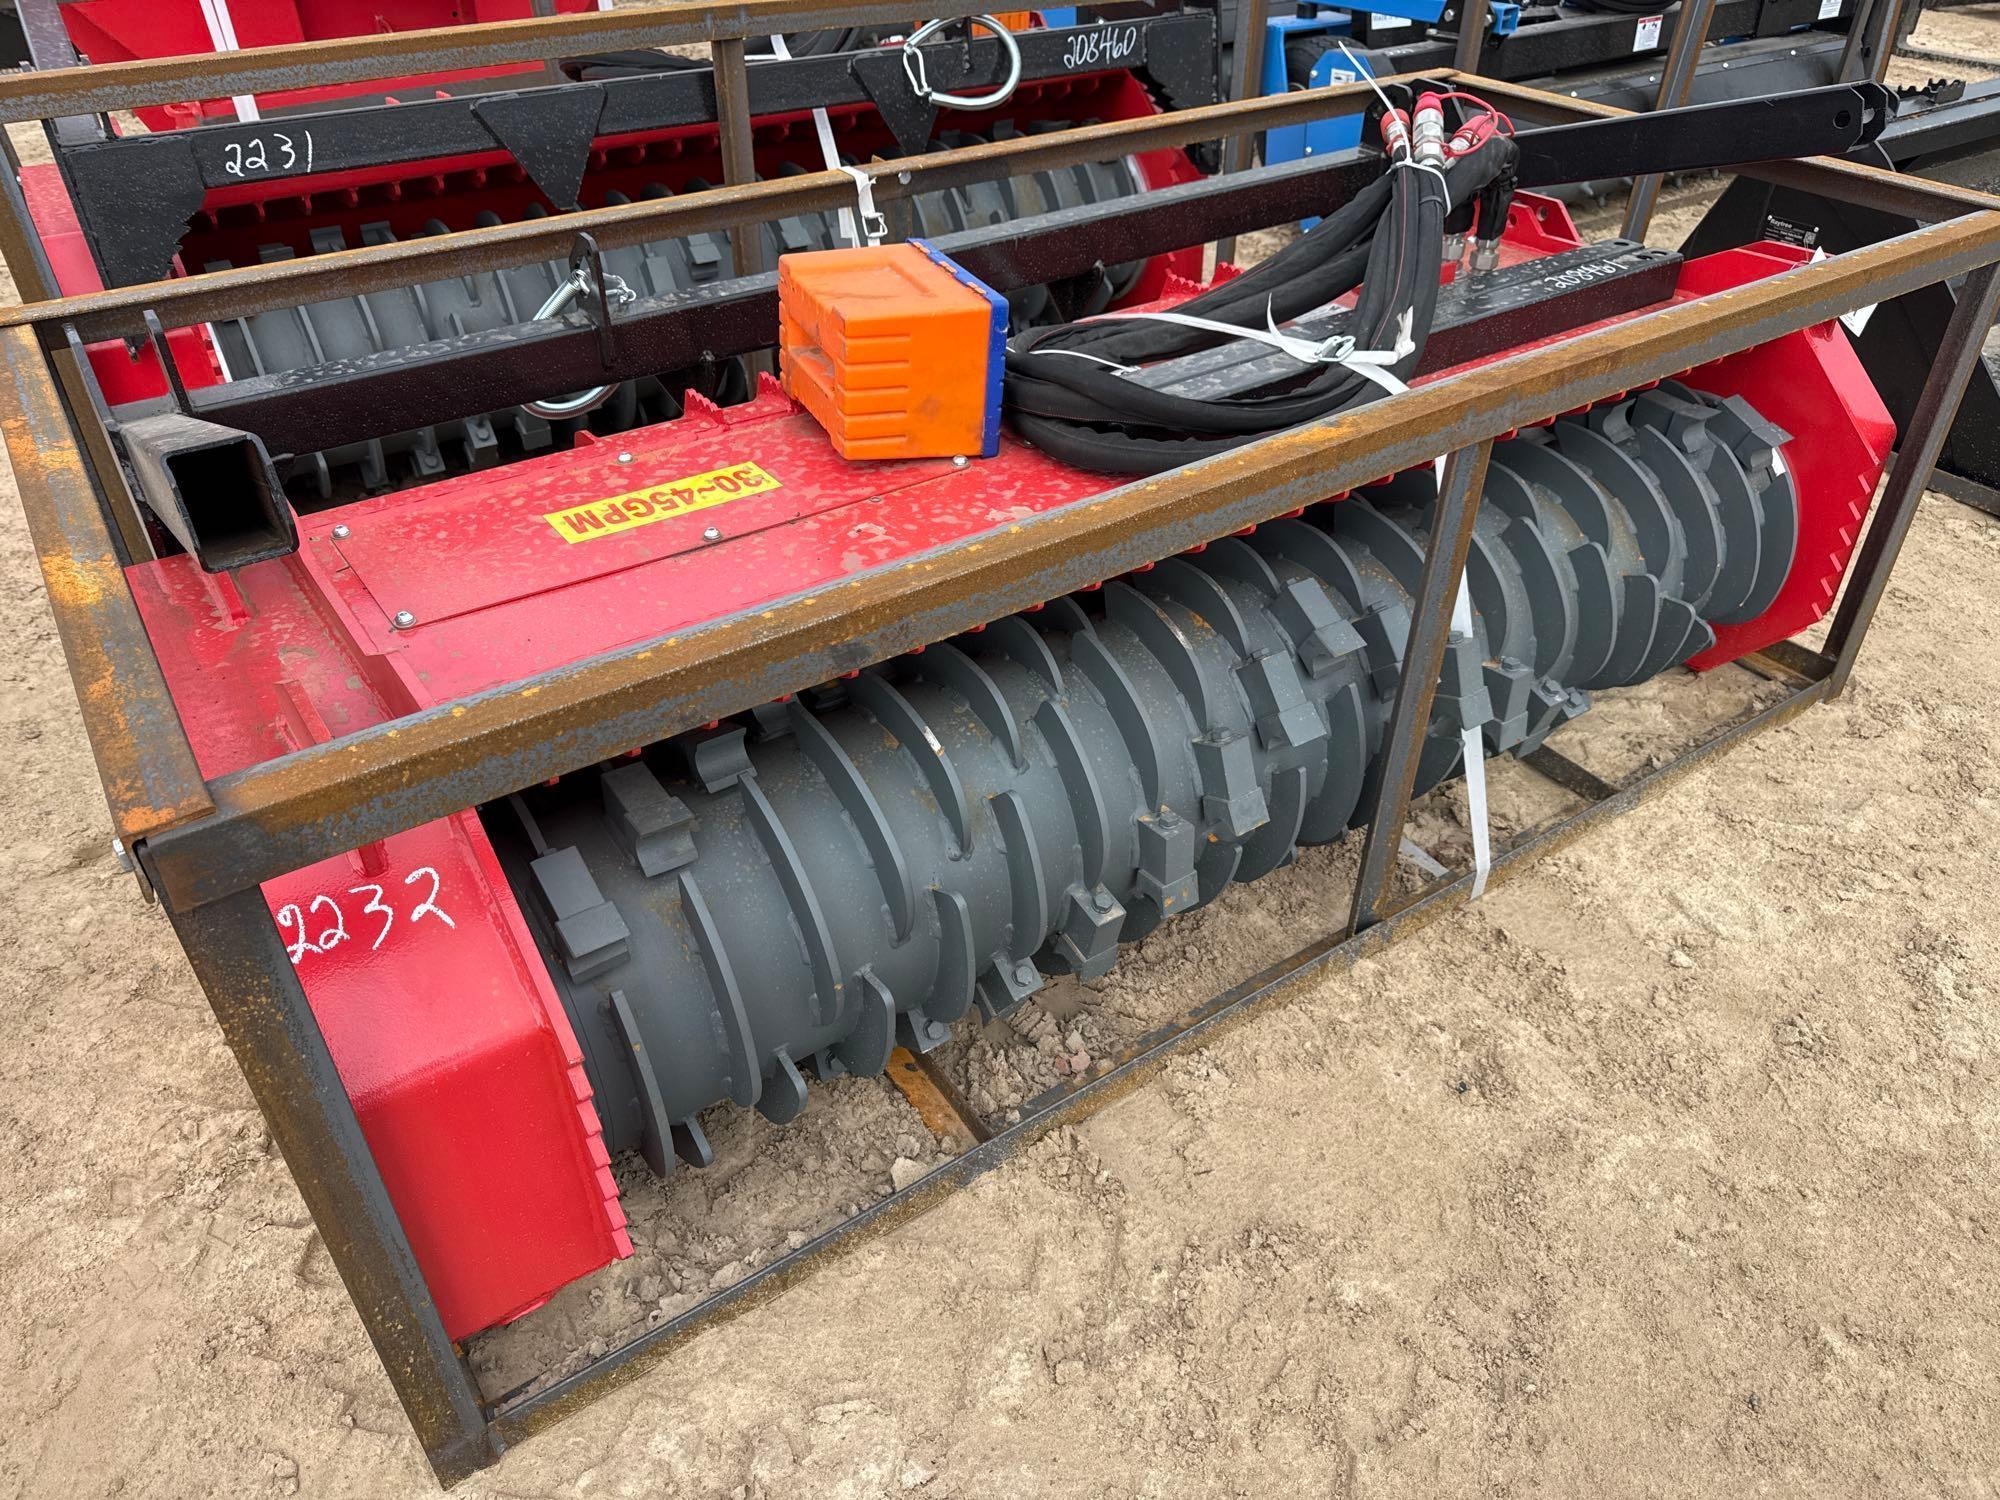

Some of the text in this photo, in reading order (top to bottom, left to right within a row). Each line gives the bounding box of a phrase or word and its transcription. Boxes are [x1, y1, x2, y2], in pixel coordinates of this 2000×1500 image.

[1063, 26, 1137, 69] 208460
[224, 130, 313, 177] 2231
[1543, 259, 1629, 289] 208461
[562, 469, 763, 535] 30~45GPM
[276, 867, 456, 965] 2232
